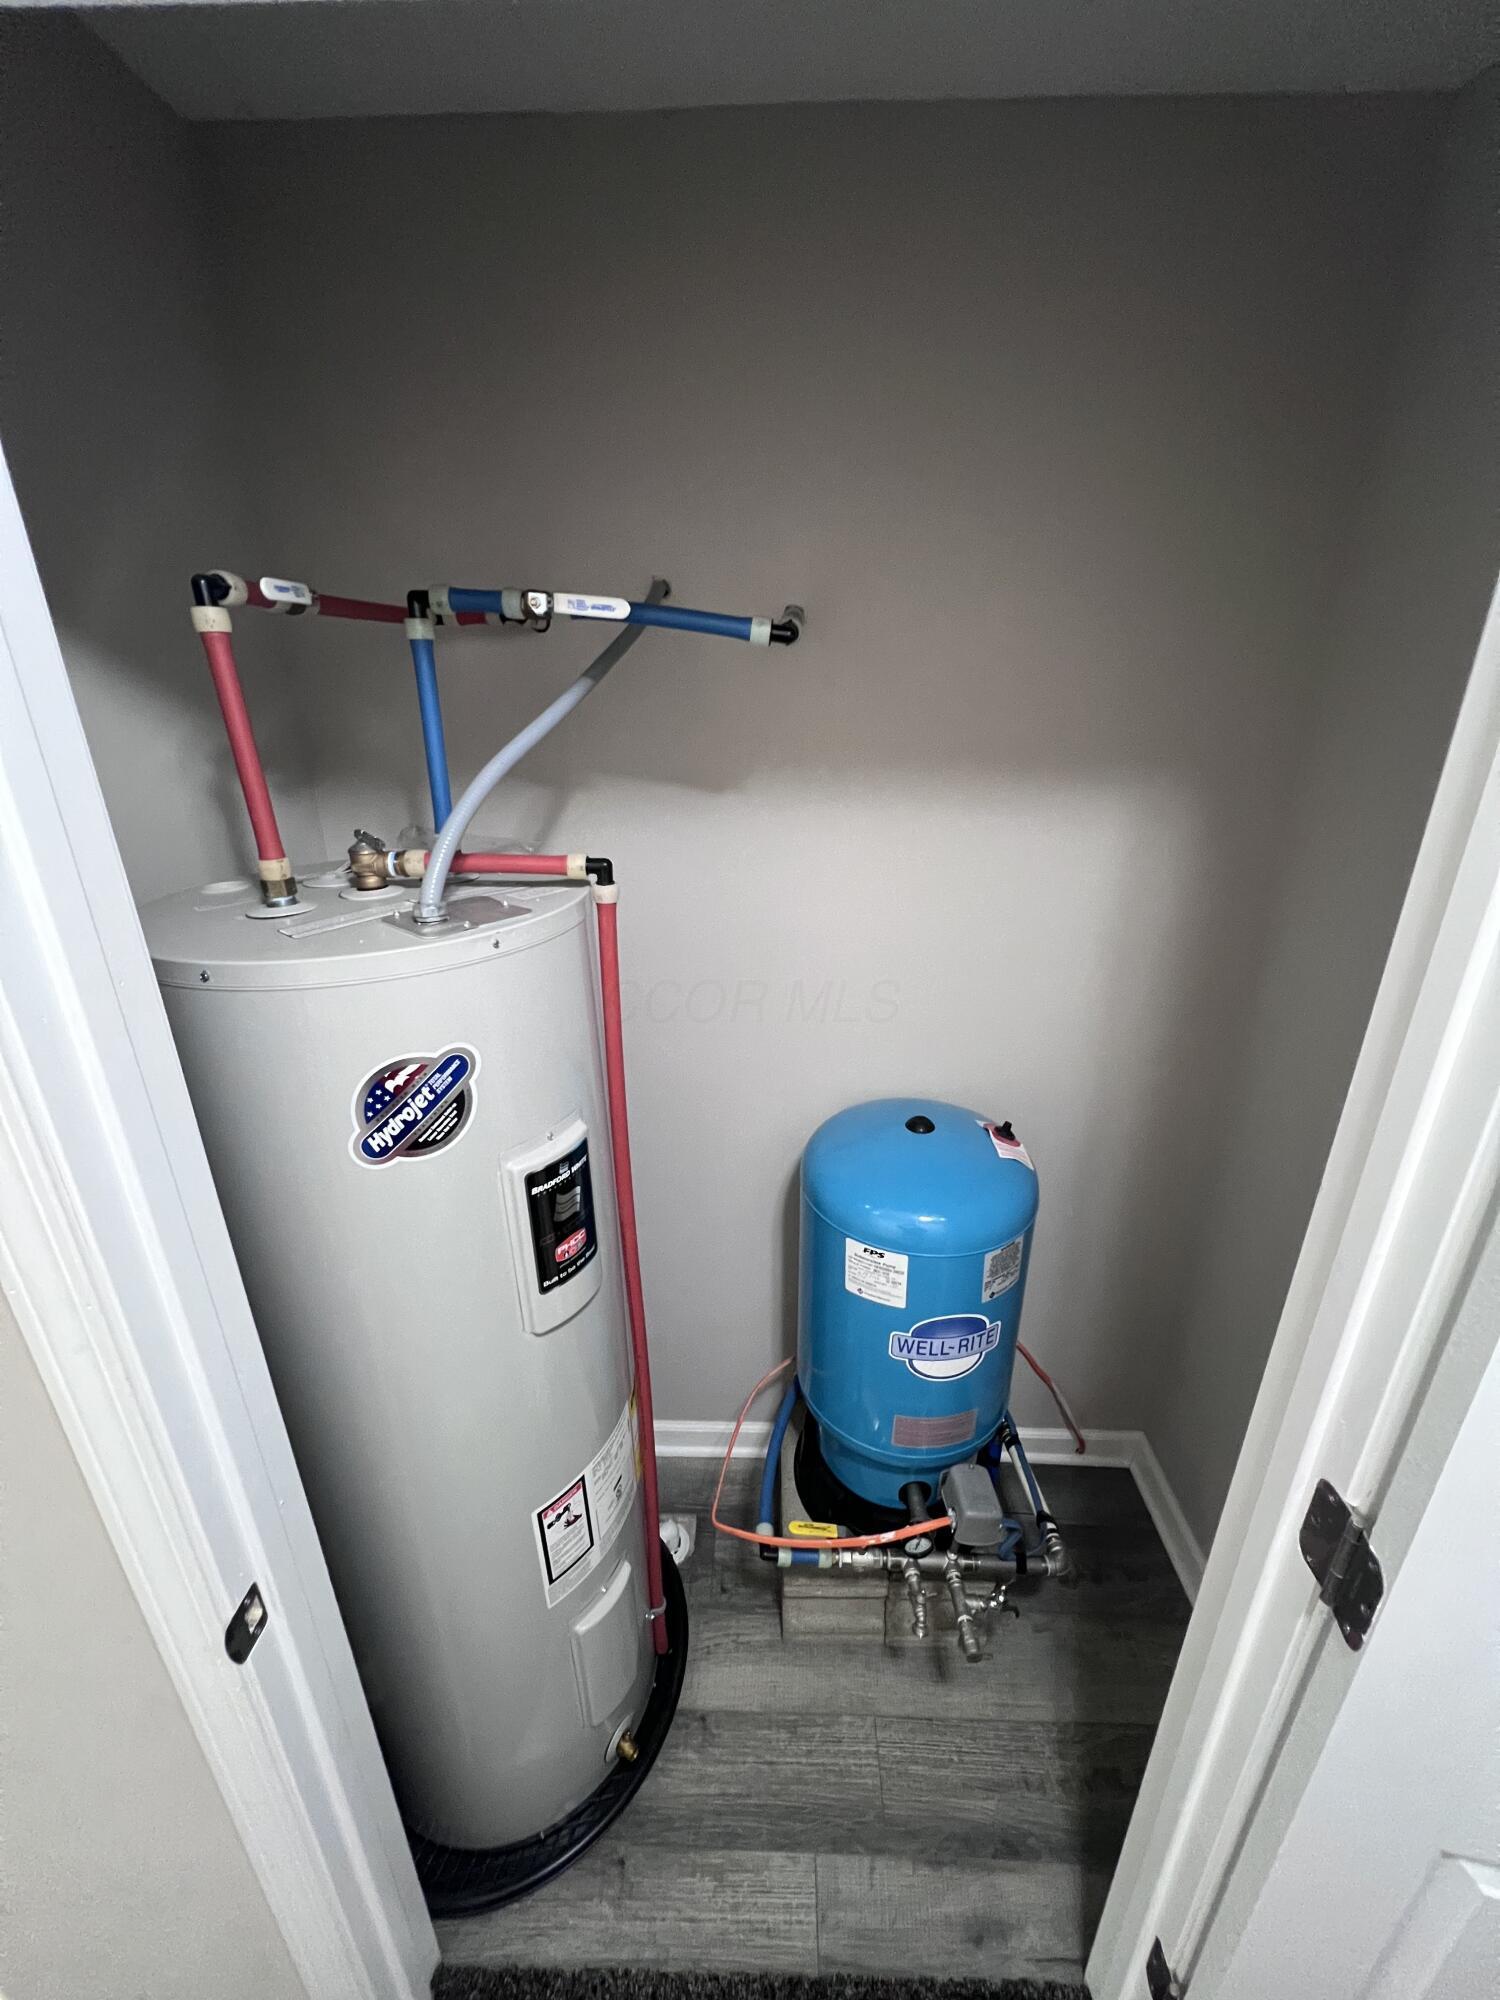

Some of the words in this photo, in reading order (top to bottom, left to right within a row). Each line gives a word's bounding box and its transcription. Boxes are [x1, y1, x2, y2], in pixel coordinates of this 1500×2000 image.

[367, 1085, 435, 1152] Hydrojet
[531, 1170, 570, 1196] BRADFORD
[863, 1247, 885, 1258] FPS
[897, 1327, 996, 1357] WELL-RITE
